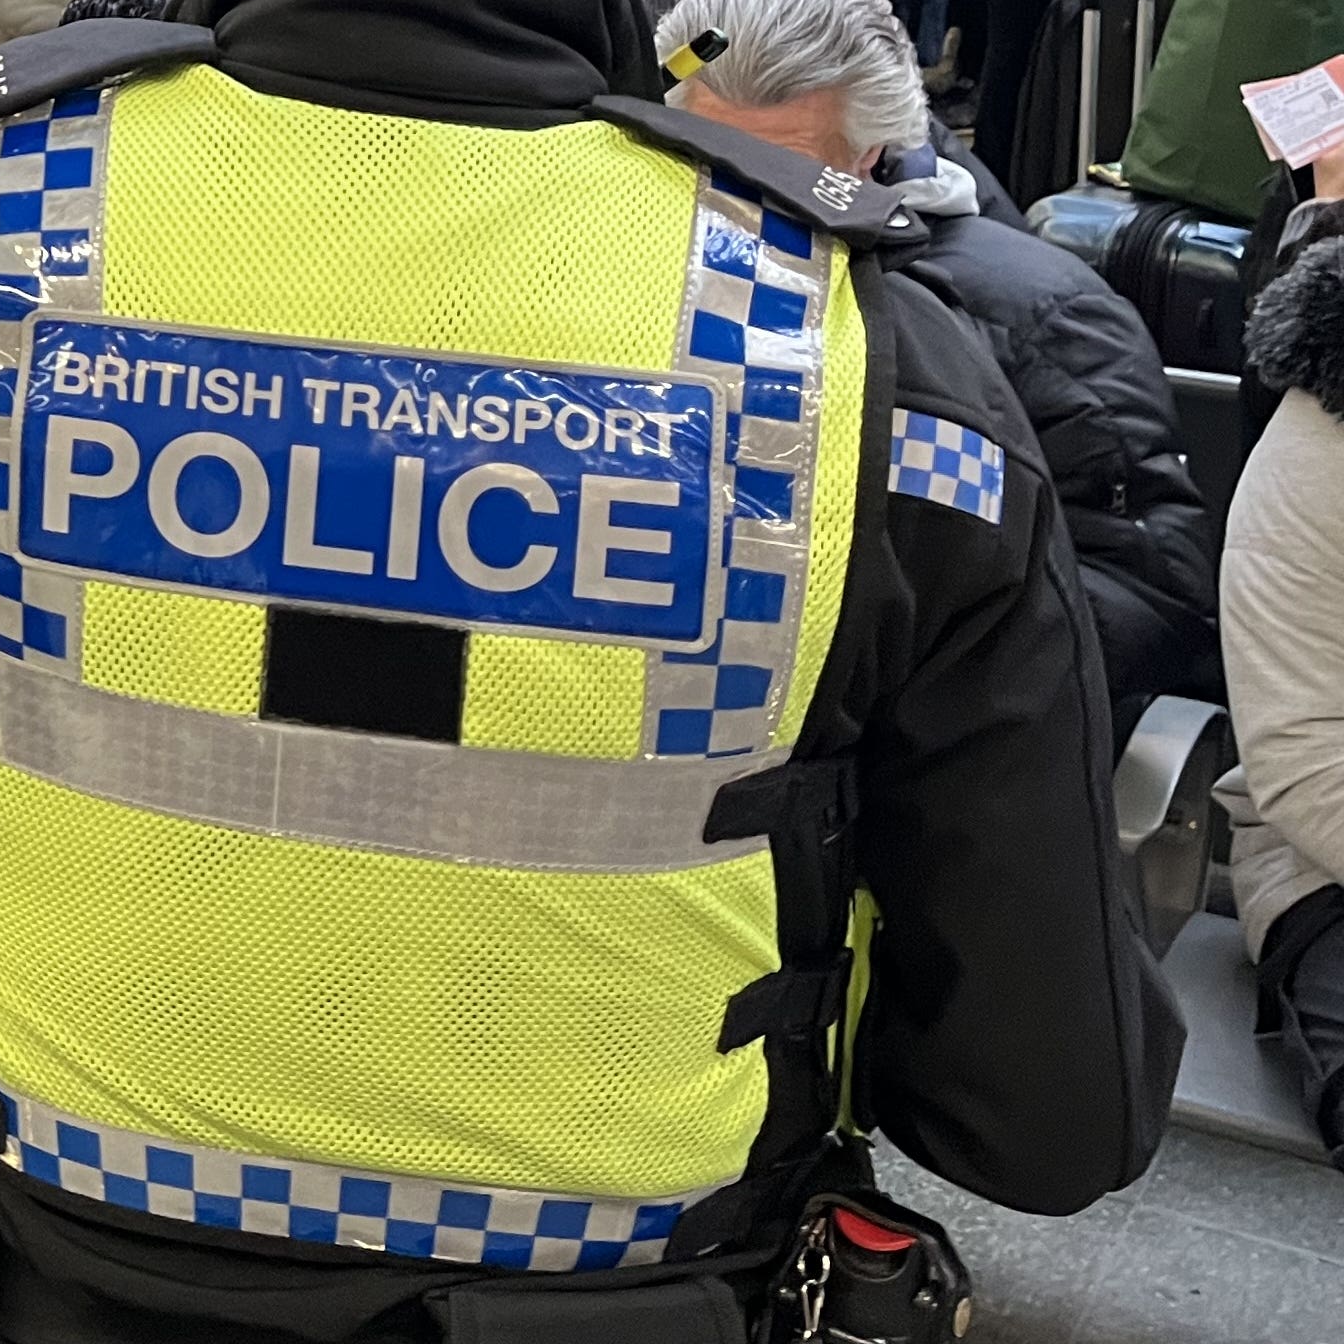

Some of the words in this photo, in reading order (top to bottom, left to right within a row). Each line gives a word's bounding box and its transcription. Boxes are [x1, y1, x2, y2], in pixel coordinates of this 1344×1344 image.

[812, 166, 862, 211] 0545
[52, 351, 283, 419] BRITISH
[303, 378, 689, 459] TRANSPORT
[41, 415, 682, 607] POLICE
